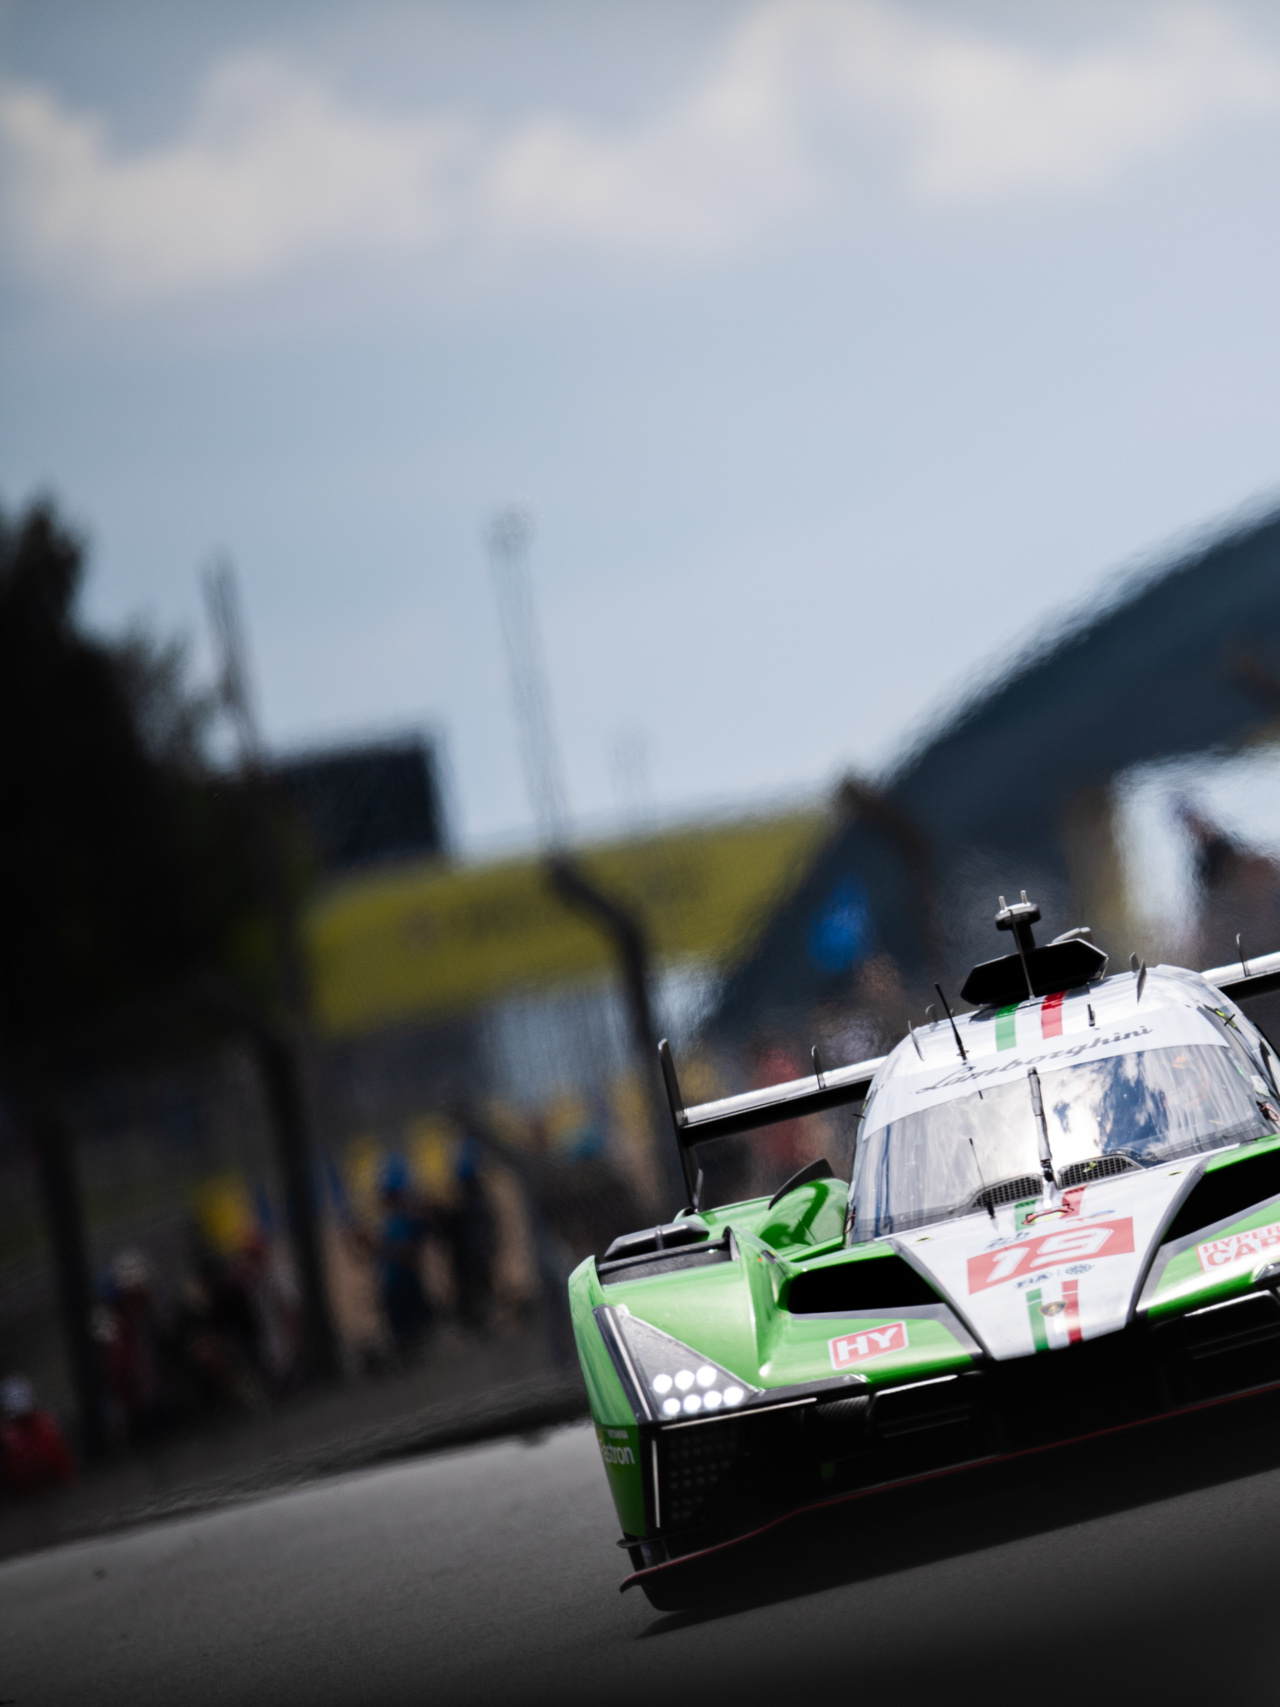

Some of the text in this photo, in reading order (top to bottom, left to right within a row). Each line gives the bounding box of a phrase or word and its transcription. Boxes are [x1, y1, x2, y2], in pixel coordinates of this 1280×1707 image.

[916, 1026, 1153, 1094] Lamborghini
[986, 1227, 1115, 1283] 19
[1016, 1272, 1050, 1289] FIA
[836, 1326, 900, 1365] HY
